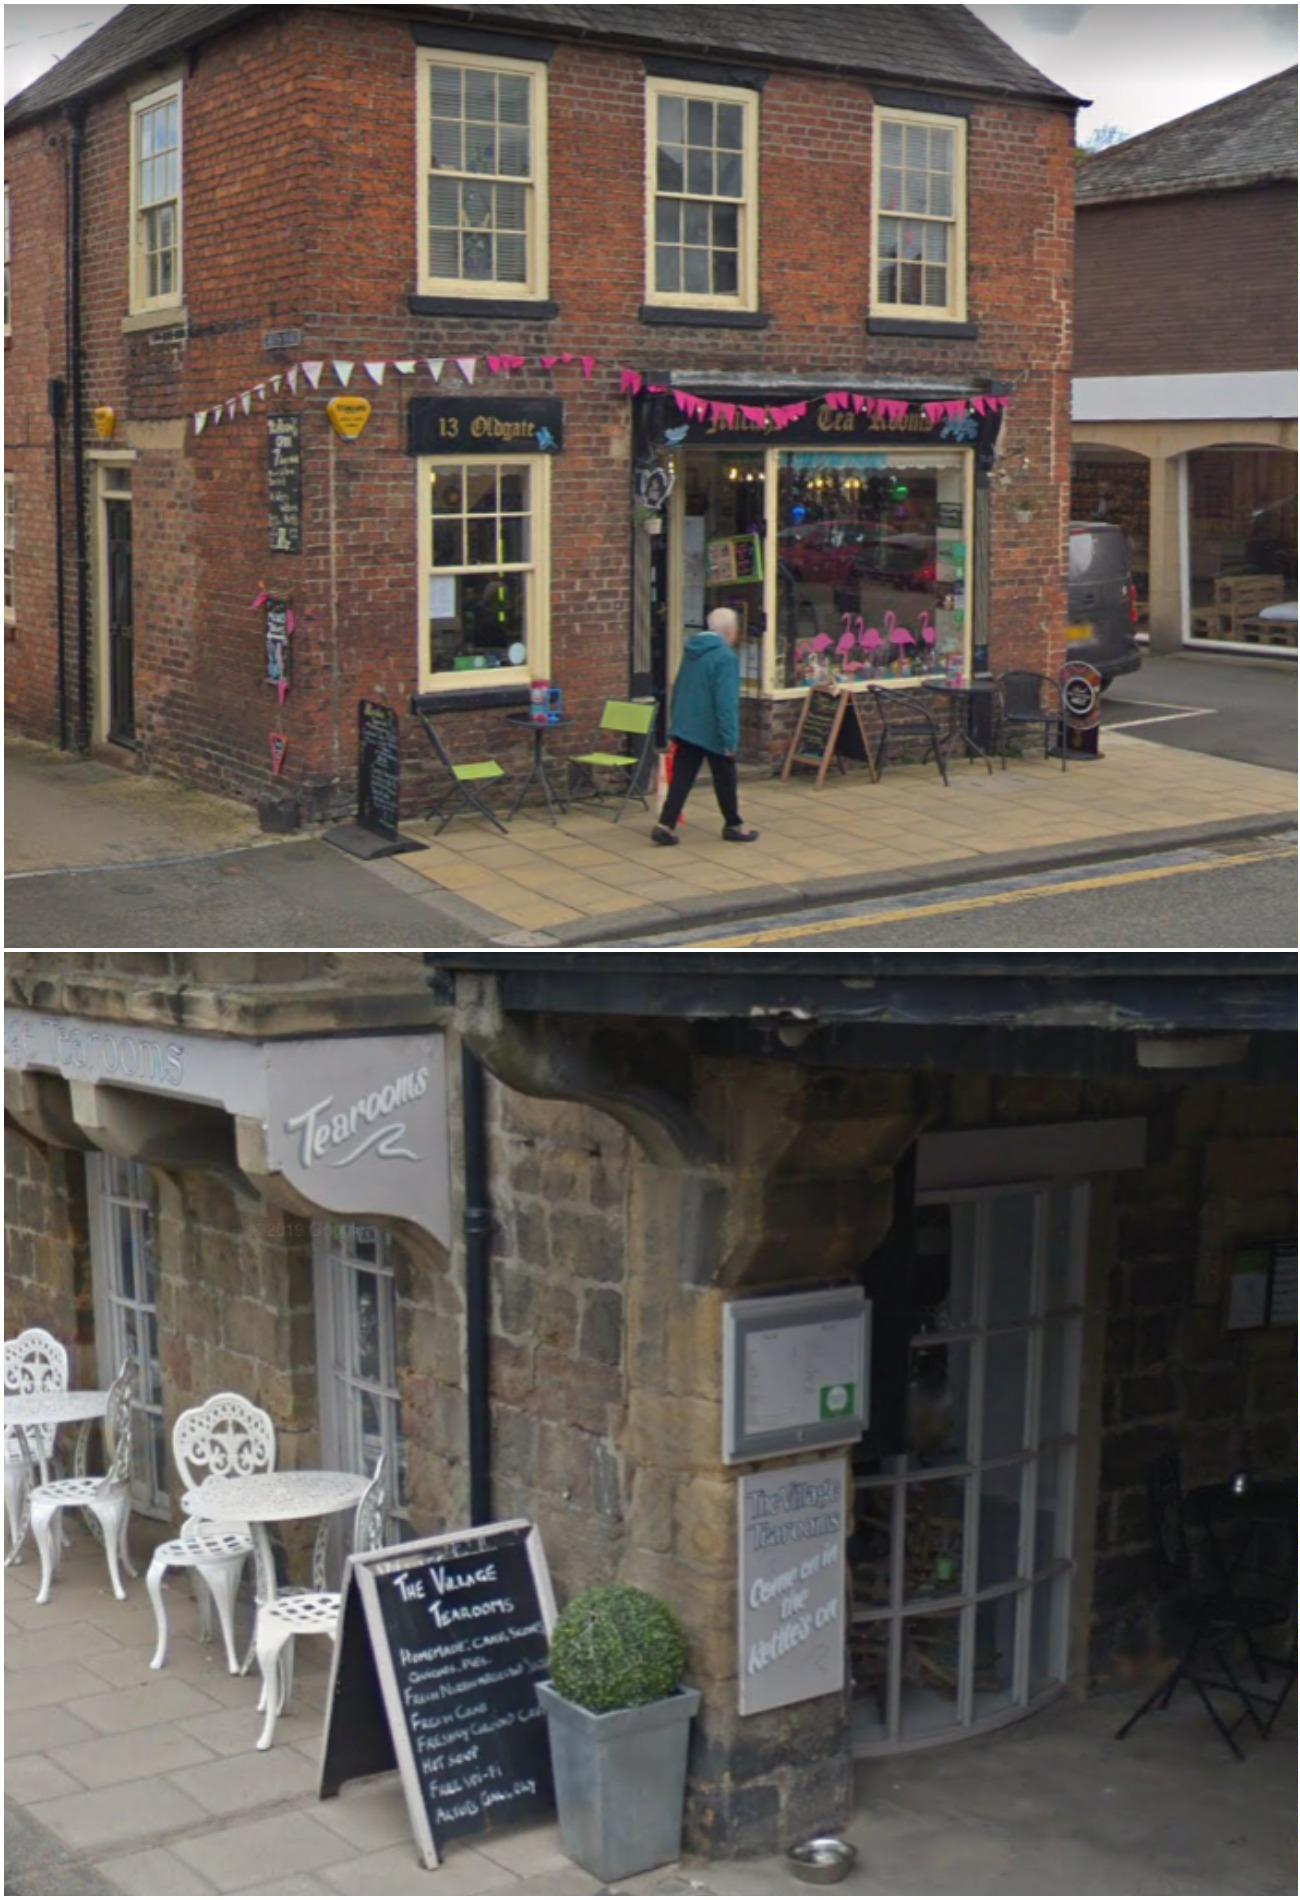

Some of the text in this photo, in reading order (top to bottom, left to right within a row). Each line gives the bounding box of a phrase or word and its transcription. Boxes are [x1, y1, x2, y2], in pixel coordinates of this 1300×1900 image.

[438, 415, 536, 441] 13 Oldgate
[817, 403, 855, 433] Tea
[868, 408, 936, 433] Rooms
[284, 1066, 430, 1169] Tearooms
[745, 1512, 841, 1552] Tearooms
[393, 1563, 498, 1602] THE VILLAGE
[749, 1567, 799, 1610] Come
[428, 1597, 515, 1629] TEAROOMS
[421, 1754, 446, 1775] HOT
